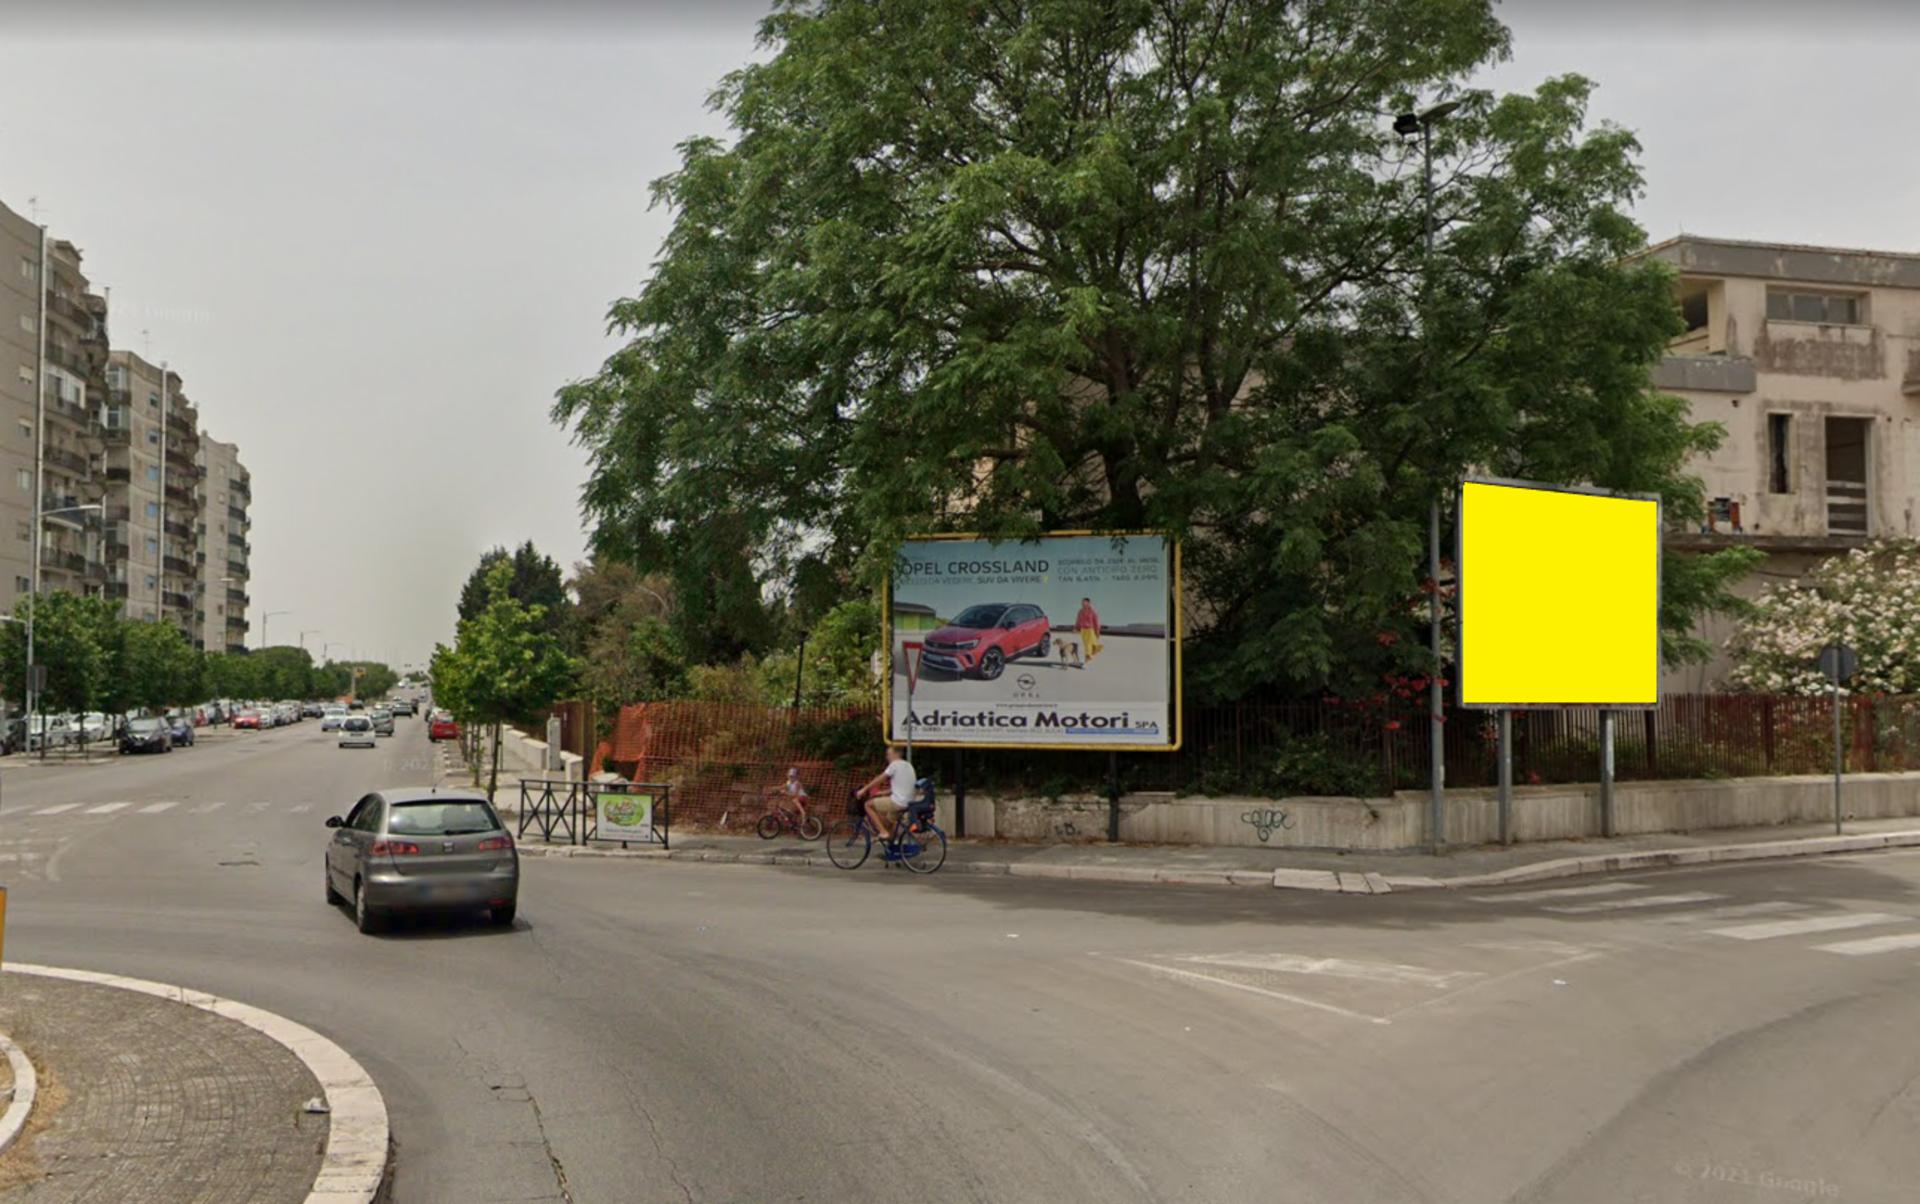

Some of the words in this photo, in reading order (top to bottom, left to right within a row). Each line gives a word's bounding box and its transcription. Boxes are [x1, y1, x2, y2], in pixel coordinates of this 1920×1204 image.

[902, 561, 943, 576] OPEL
[947, 560, 1050, 575] CROSSLAND
[902, 710, 1027, 727] Adriatica
[1035, 711, 1128, 728] Motori
